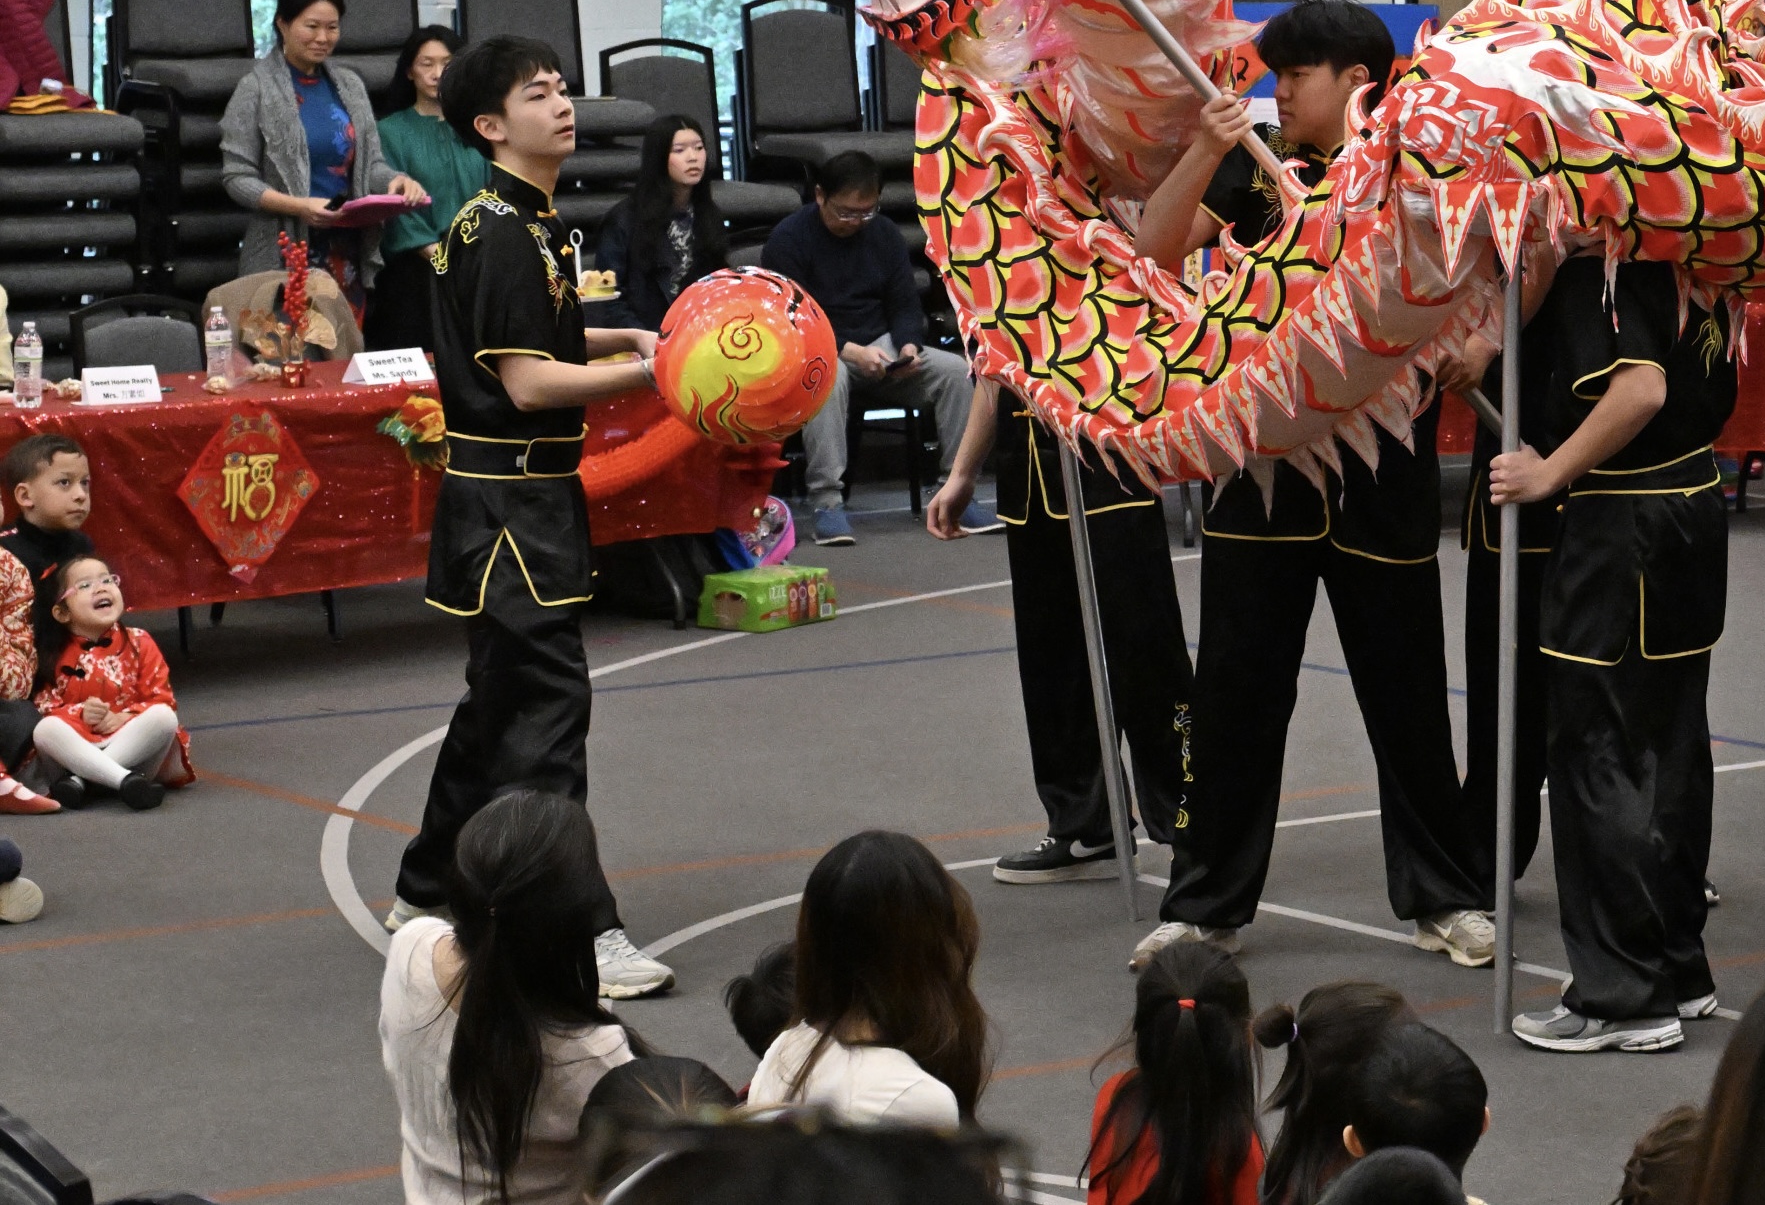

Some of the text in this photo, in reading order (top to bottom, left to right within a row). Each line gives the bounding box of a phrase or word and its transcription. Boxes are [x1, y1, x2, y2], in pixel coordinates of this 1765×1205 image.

[368, 356, 413, 366] Sweet Tea
[389, 370, 418, 378] Sandy
[221, 452, 280, 522] 福
